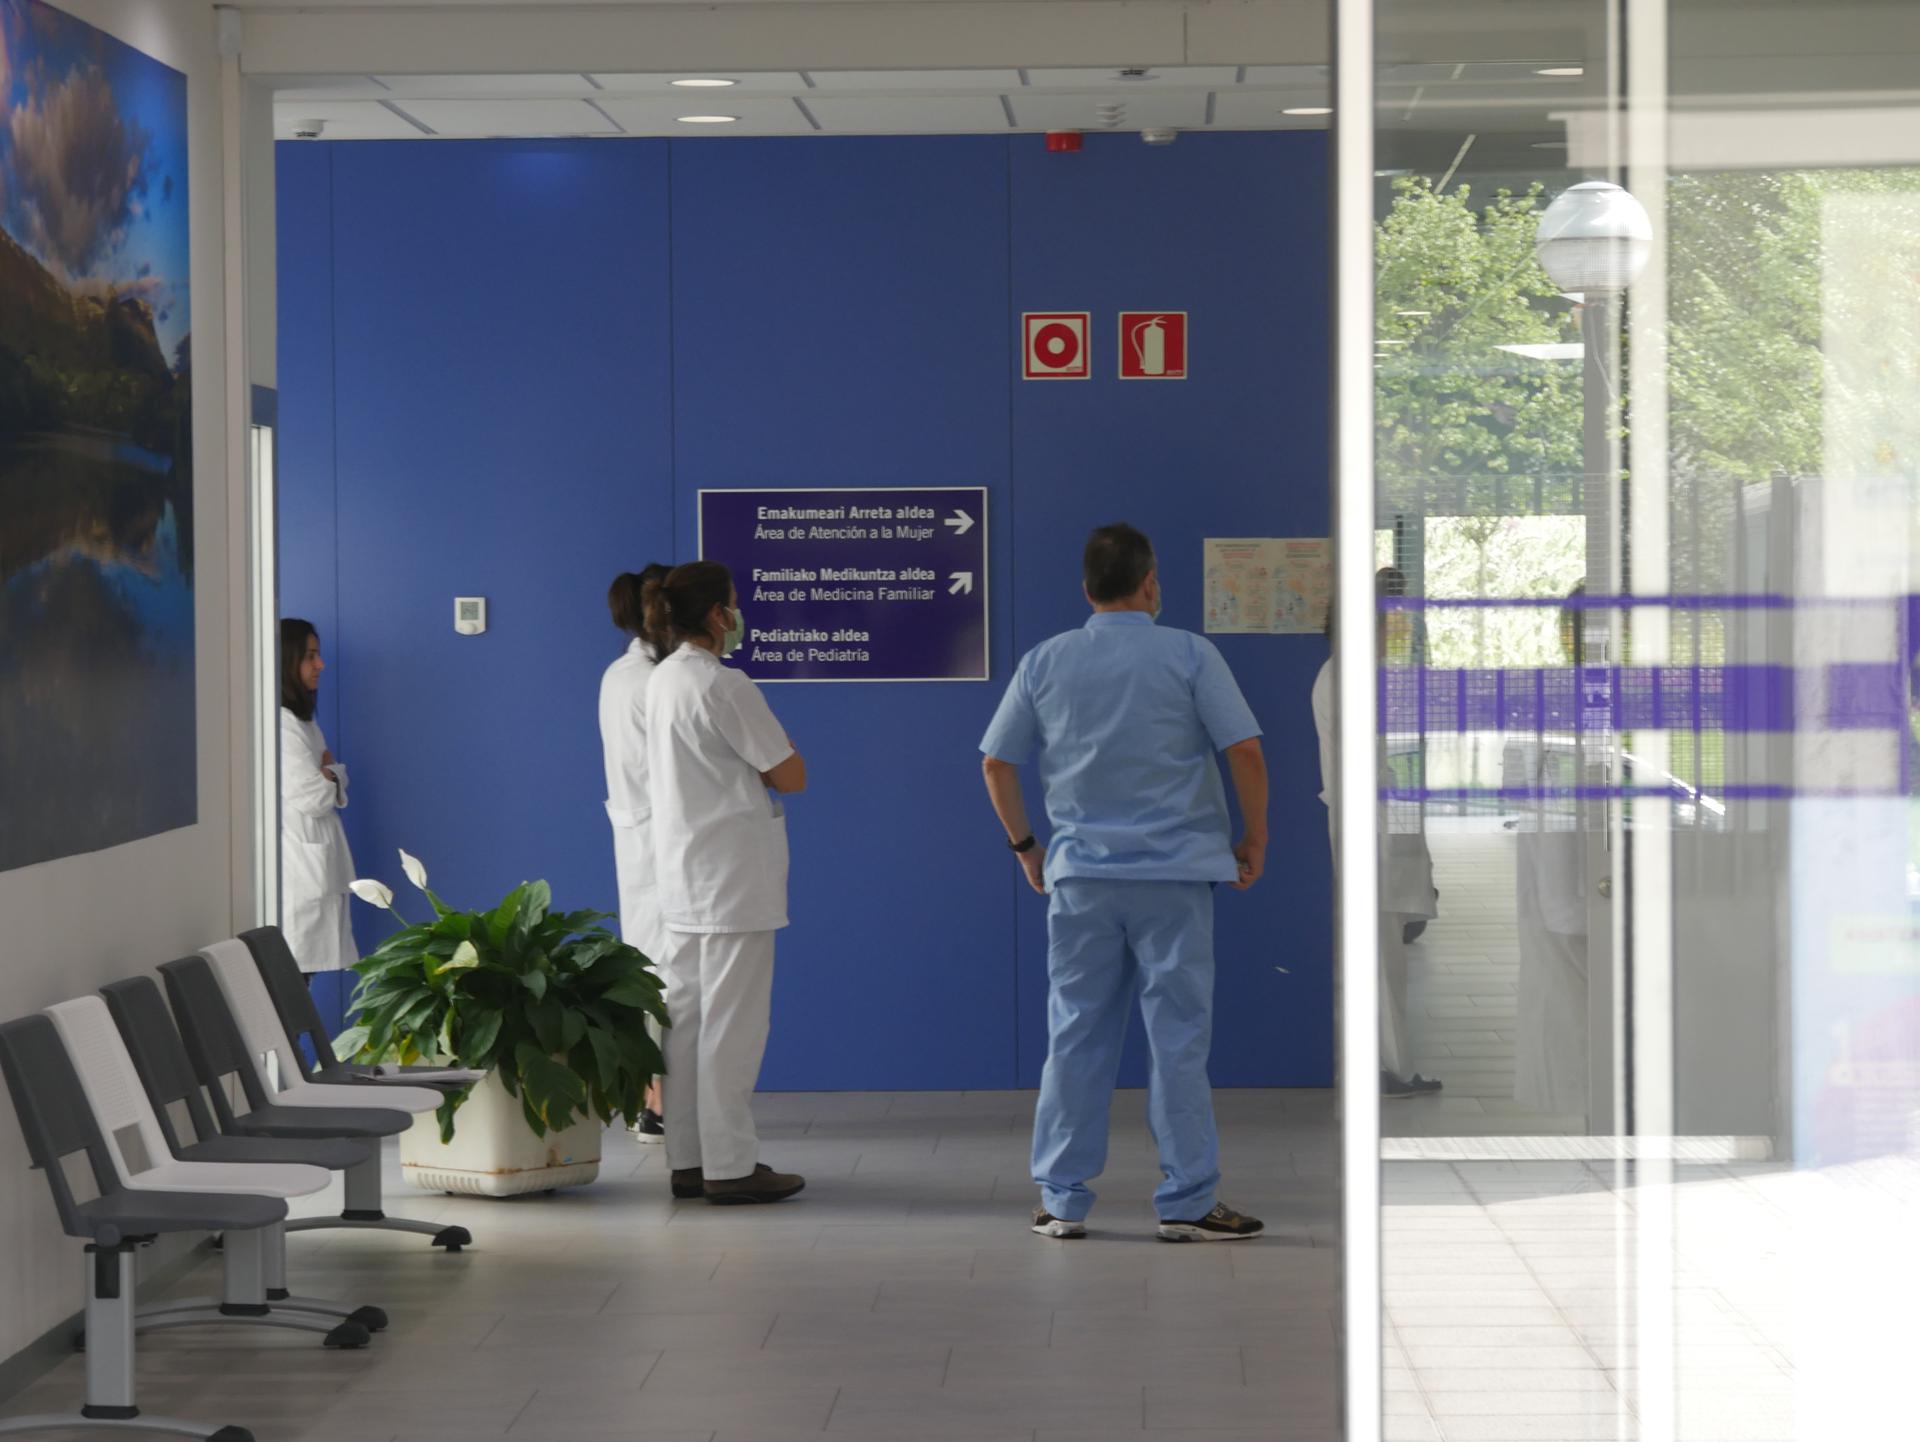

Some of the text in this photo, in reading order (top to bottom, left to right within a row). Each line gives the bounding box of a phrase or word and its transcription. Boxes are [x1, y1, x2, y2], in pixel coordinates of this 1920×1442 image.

[757, 505, 935, 520] Emakumeari Arreta aldea
[754, 523, 935, 542] Área de Atención a la Mujer
[752, 567, 936, 582] Familiako Medikuntza aldea
[752, 585, 935, 602] Área de Medicina Familiar
[750, 628, 870, 643] Pediatriako aldea
[751, 646, 870, 662] Área de Pediatría
